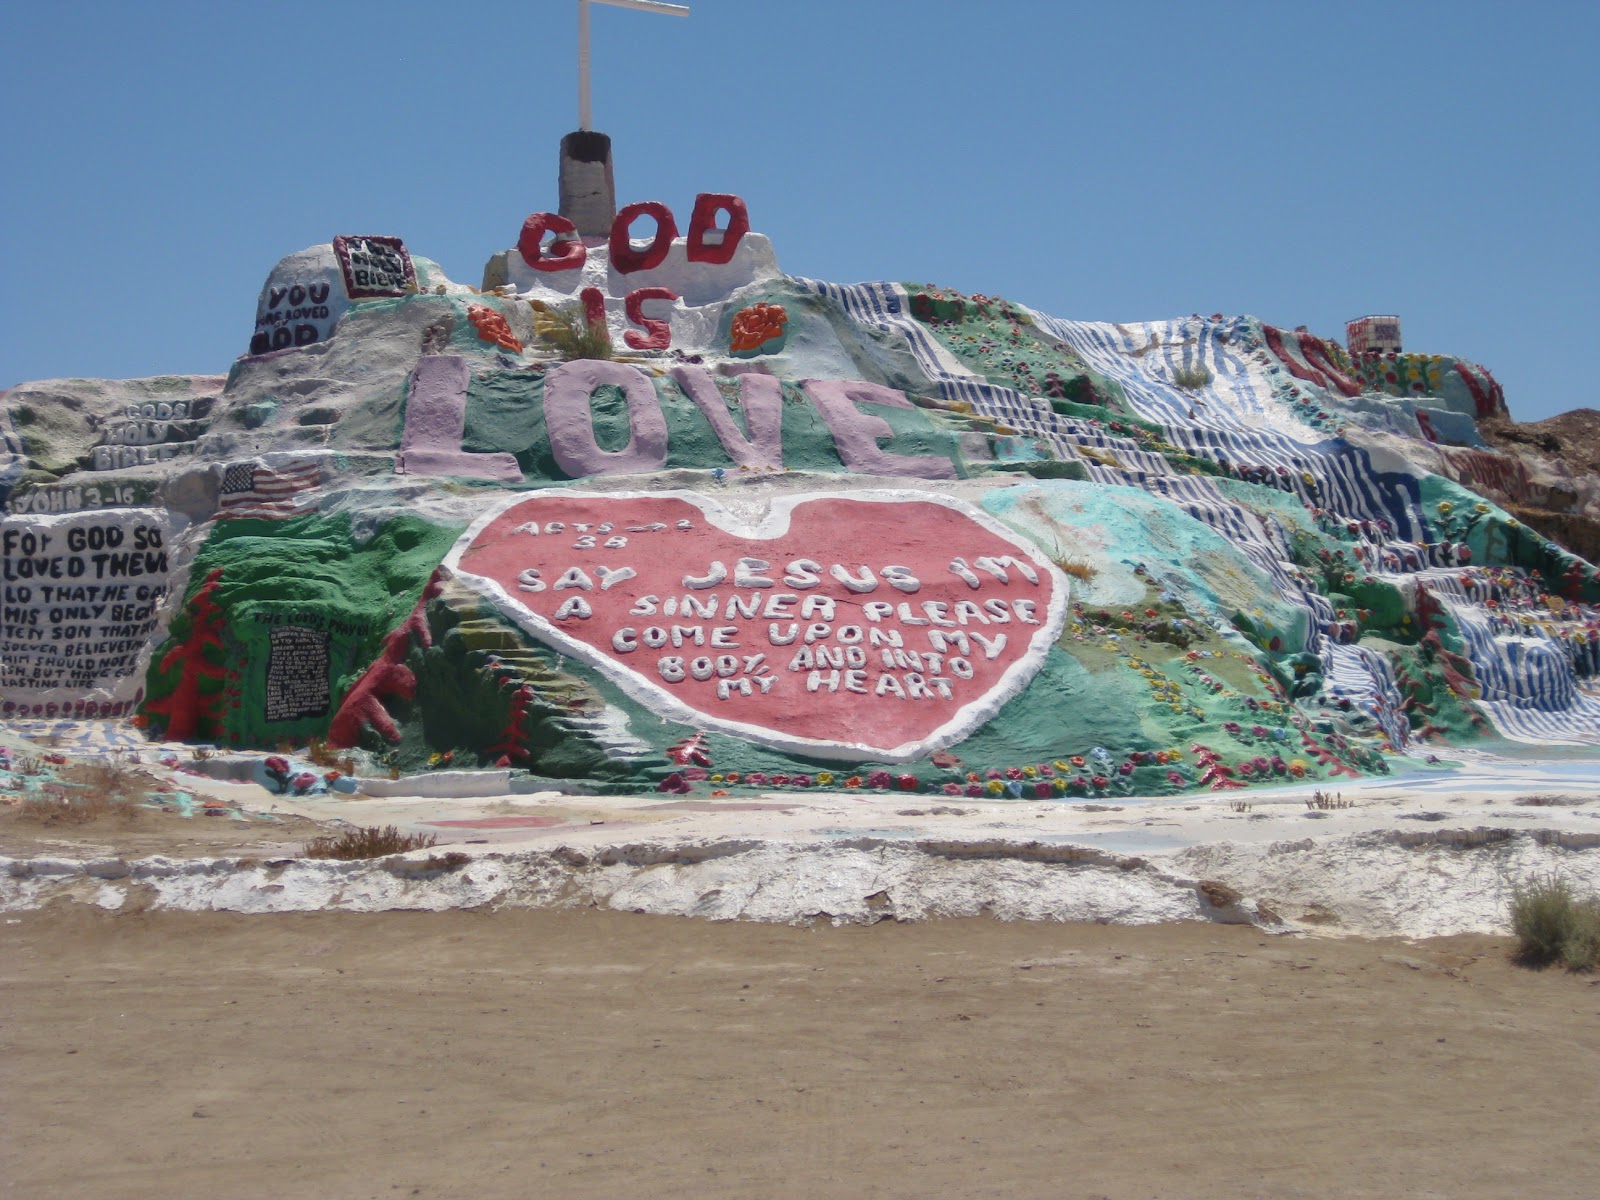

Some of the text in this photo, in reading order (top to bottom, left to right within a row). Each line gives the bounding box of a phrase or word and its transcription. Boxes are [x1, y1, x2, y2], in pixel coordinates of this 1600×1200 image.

[518, 192, 750, 275] GOD
[269, 282, 330, 310] YOU
[285, 306, 330, 320] LOVED
[580, 286, 679, 350] IS
[126, 402, 187, 420] GODS
[396, 355, 958, 483] LOVE
[94, 445, 179, 471] BIBLE
[16, 487, 82, 514] JOHN
[67, 524, 125, 552] GOD
[133, 524, 163, 550] SO
[511, 521, 614, 537] ACTS
[3, 556, 85, 581] LOVED
[517, 565, 637, 593] SAY
[682, 557, 921, 593] JESUS
[40, 585, 102, 603] THAT
[3, 605, 41, 626] HIS
[49, 605, 105, 624] ONLY
[554, 592, 1041, 629] A SINNER PLEASE
[52, 625, 92, 641] SON
[99, 623, 141, 638] THAT
[611, 622, 1008, 661] COME UPON MY
[788, 645, 868, 672] AND
[881, 647, 975, 680] INTO
[716, 669, 955, 701] MY HEART
